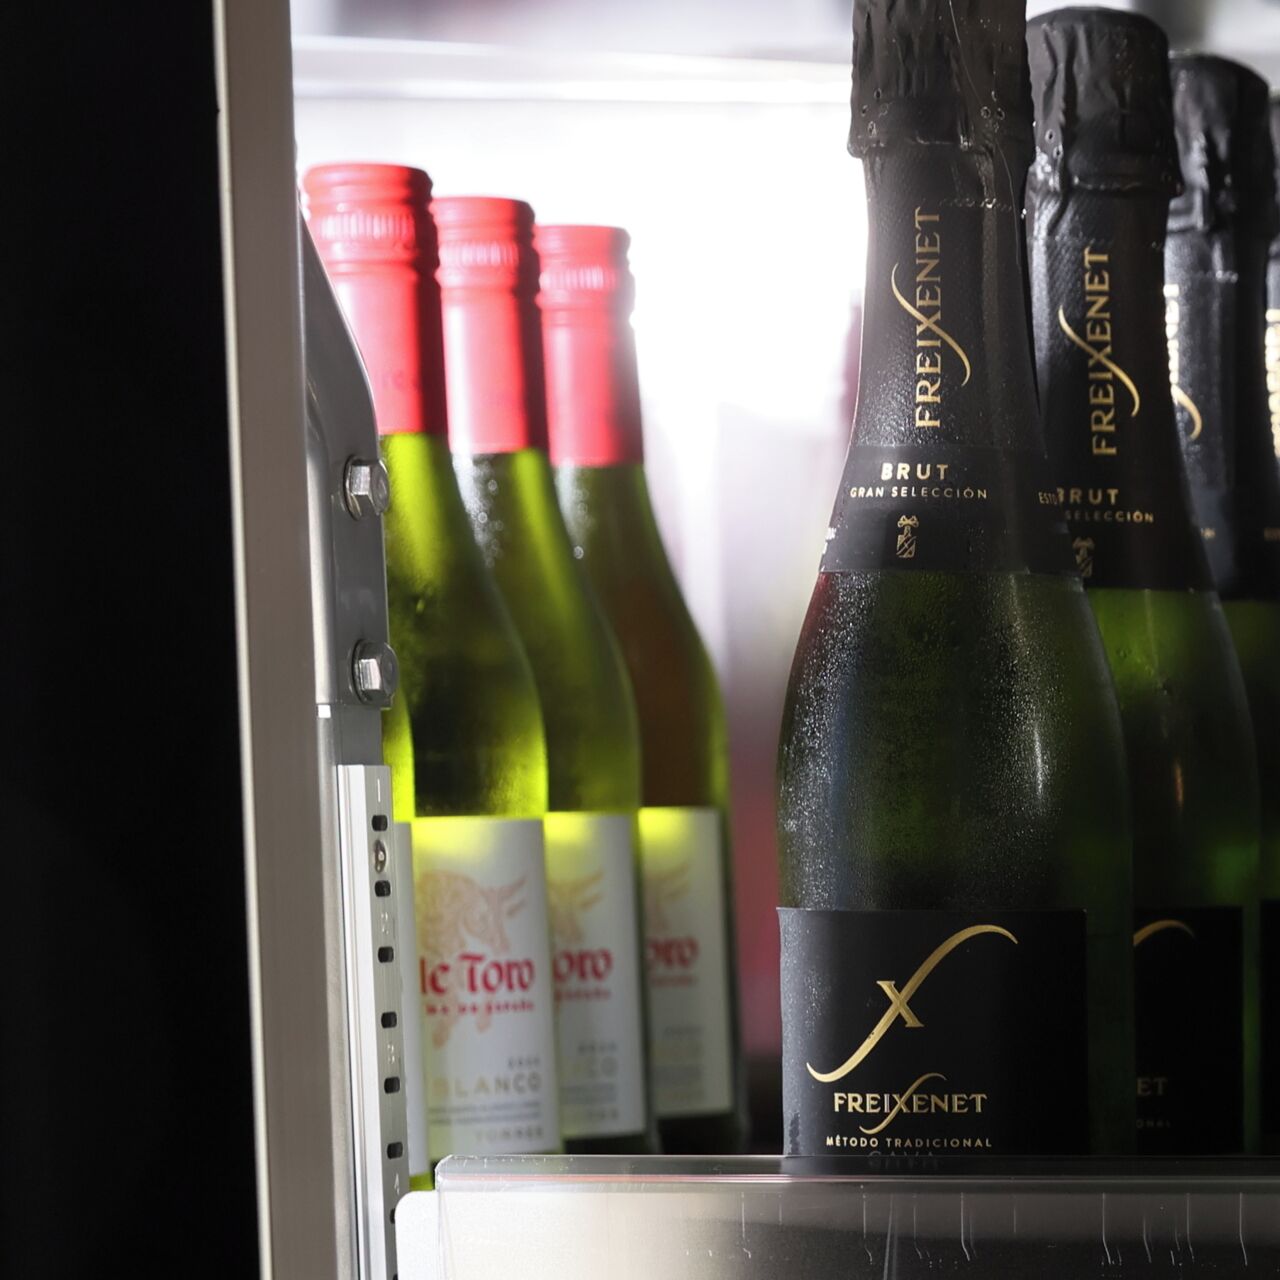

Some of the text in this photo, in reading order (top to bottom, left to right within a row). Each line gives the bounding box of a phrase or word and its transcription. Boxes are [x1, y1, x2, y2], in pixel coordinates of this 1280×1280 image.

[891, 207, 971, 429] FREIXENET
[1059, 247, 1141, 457] FREIXENET
[880, 462, 949, 482] BRUT
[850, 485, 988, 499] GRAN SELECCIÓN
[826, 1135, 993, 1149] MÉTODO TRADICIONAL
